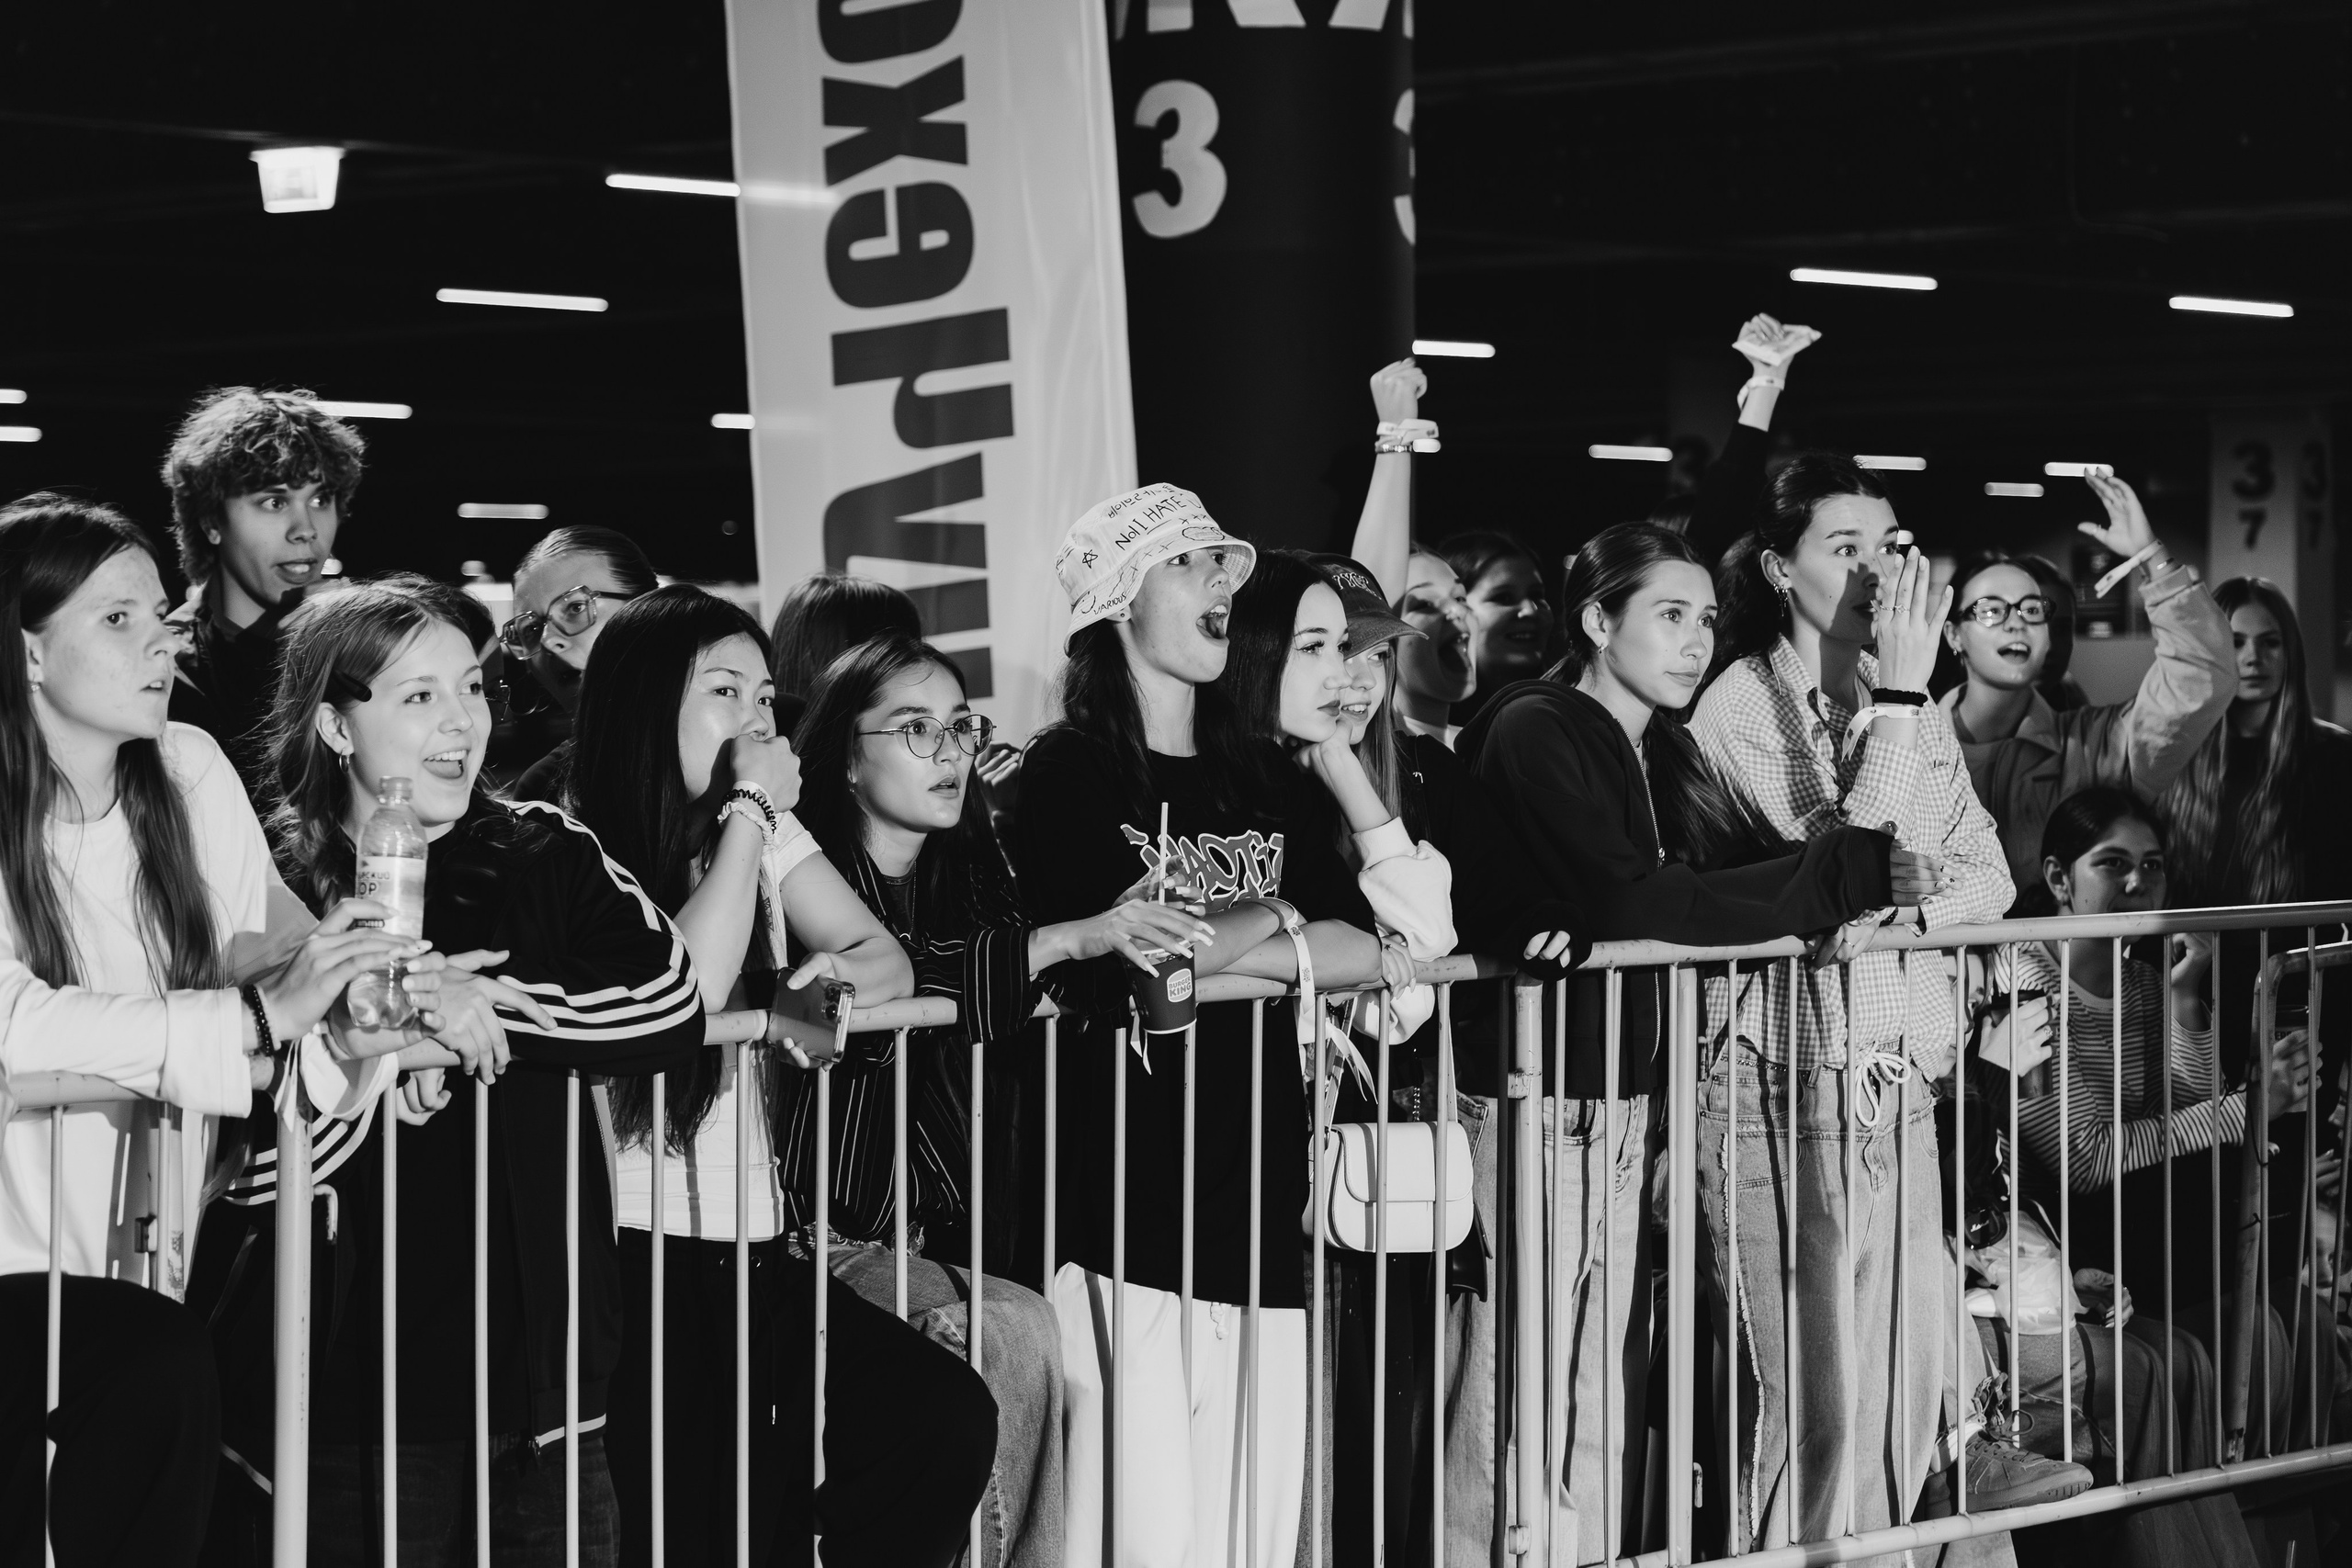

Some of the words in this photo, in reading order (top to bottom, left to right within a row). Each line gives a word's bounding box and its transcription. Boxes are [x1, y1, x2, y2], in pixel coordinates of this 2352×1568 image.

[1133, 79, 1227, 239] 3
[2233, 440, 2276, 502] 3
[1142, 495, 1187, 523] HATE
[2238, 507, 2267, 550] 7
[1093, 592, 1127, 615] VARIOUS
[1169, 976, 1191, 989] BURGER
[1169, 982, 1192, 998] KING
